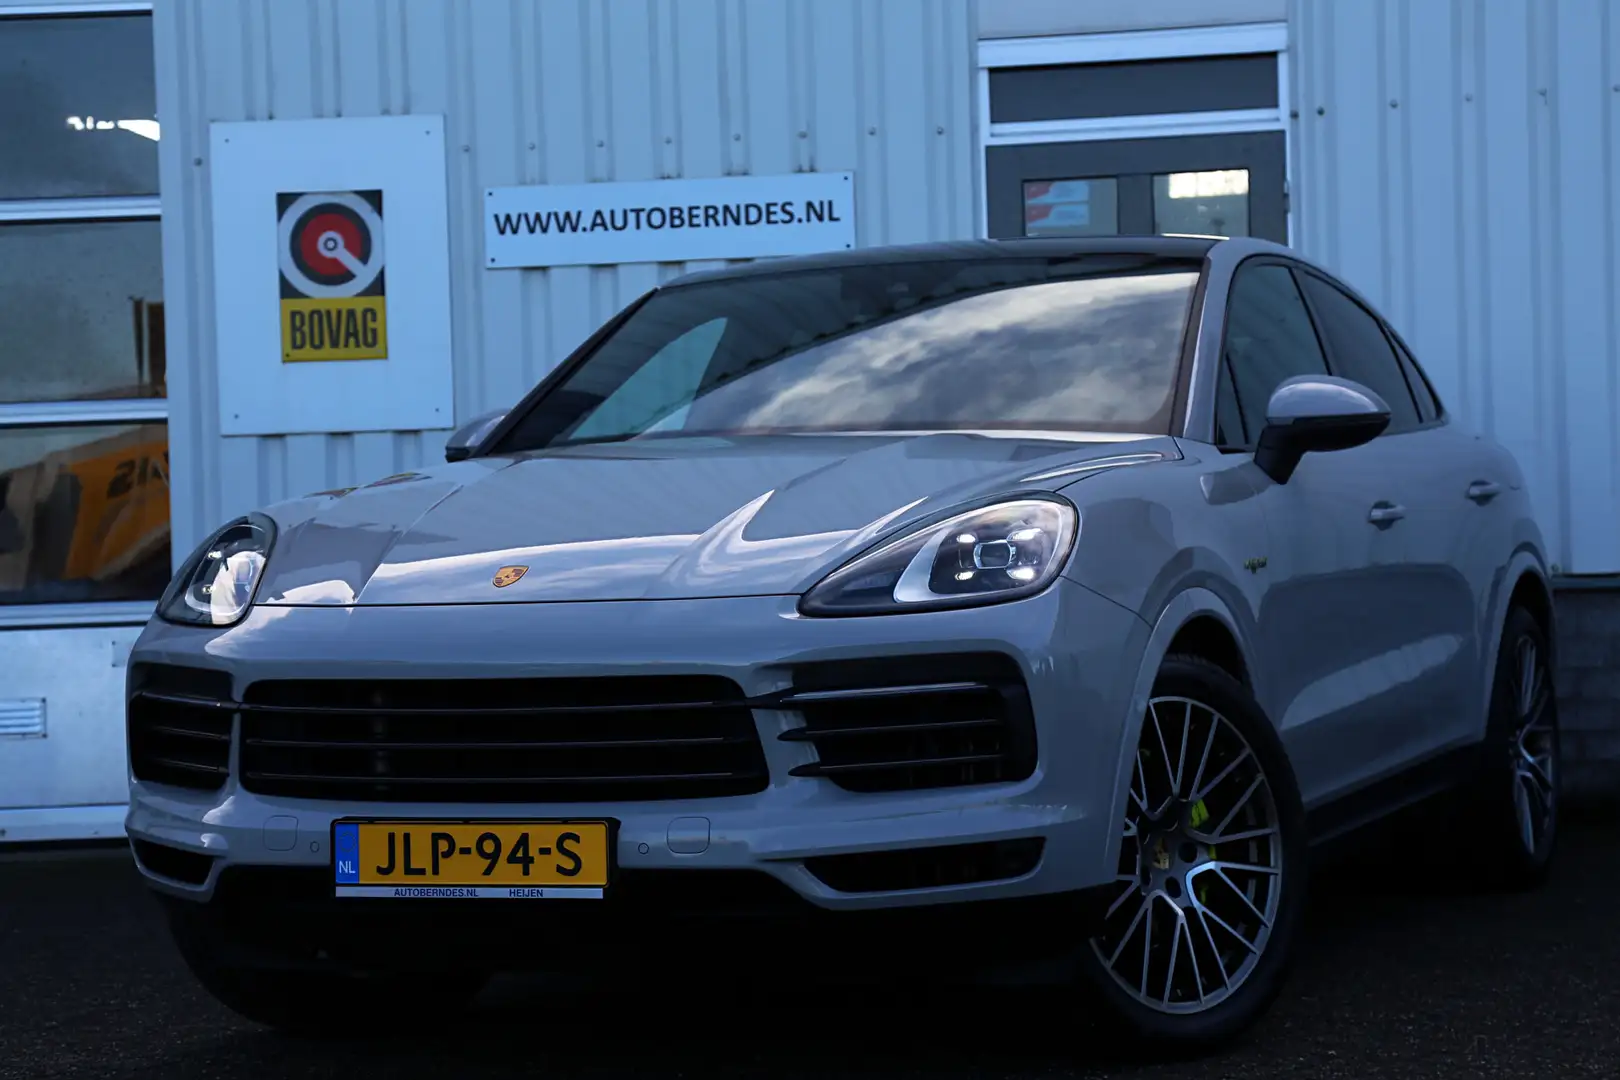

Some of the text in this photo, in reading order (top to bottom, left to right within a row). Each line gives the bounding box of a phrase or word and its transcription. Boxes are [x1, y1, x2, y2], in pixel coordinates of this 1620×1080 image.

[494, 199, 841, 236] WWW.AUTOBERNDES.NL
[290, 307, 378, 350] BOVAG
[339, 860, 356, 874] NL
[376, 831, 582, 877] JLP-94-S
[394, 888, 544, 899] AUTOBERNDES.NL HEIJEN
